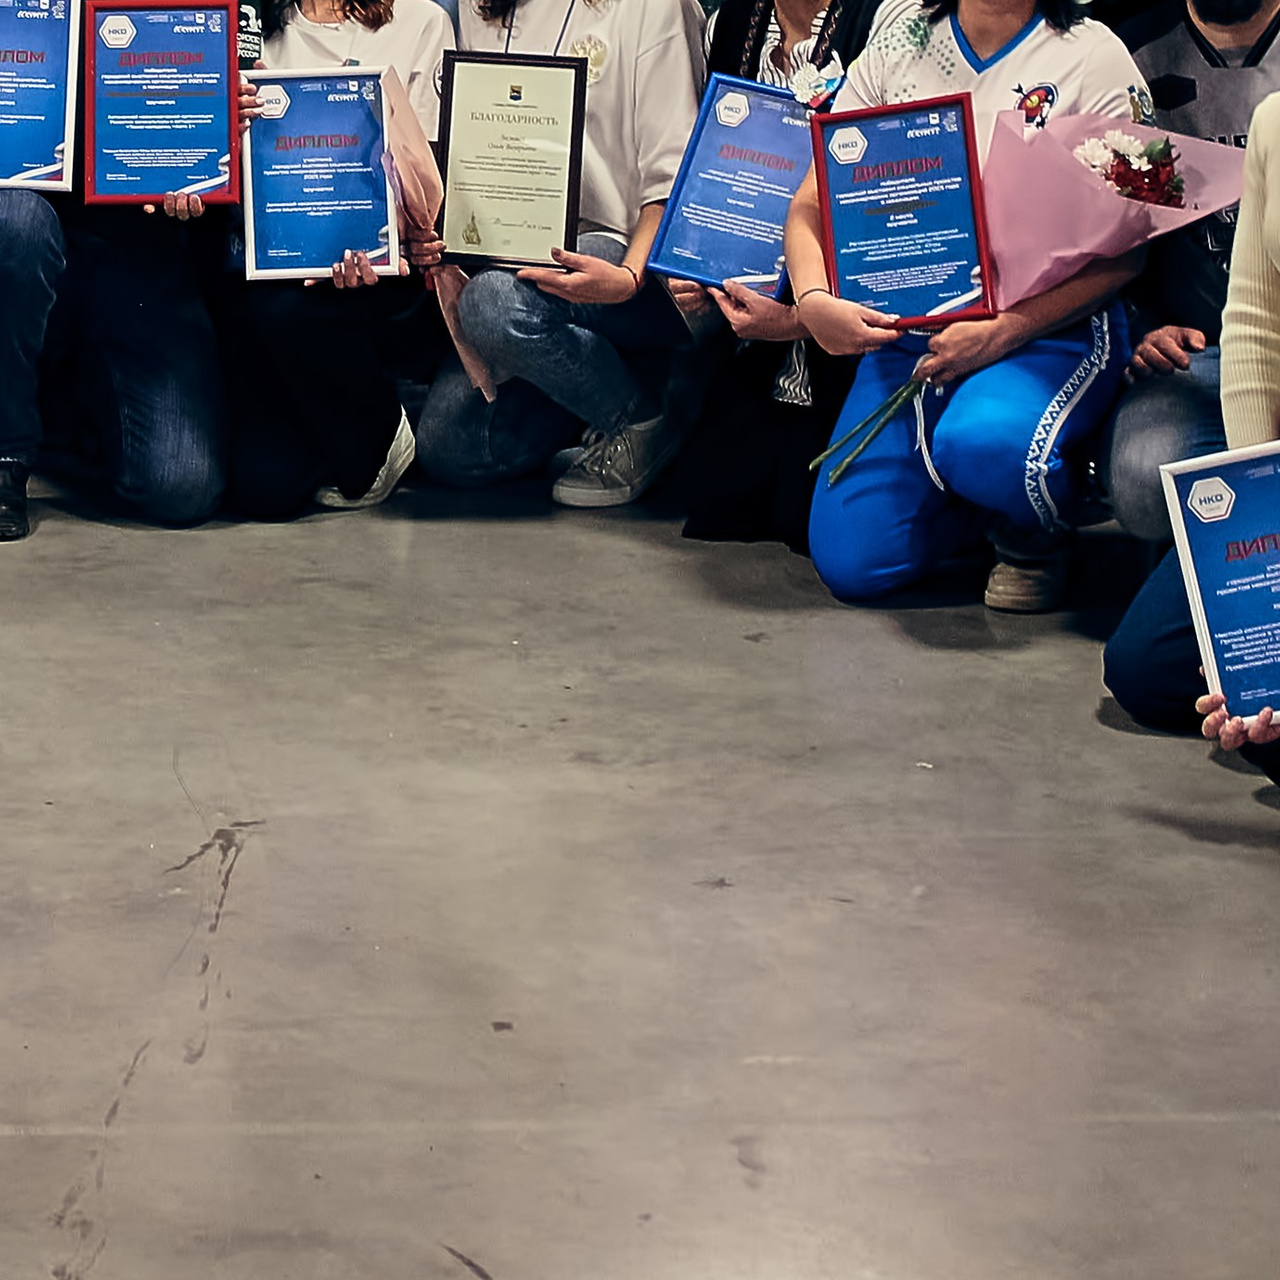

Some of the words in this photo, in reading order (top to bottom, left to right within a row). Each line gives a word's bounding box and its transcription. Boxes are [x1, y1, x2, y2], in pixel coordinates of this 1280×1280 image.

[118, 51, 204, 66] ДИПЛОМ
[470, 111, 559, 126] БЛАГОДАРНОСТЬ
[852, 156, 943, 183] ДИПЛОМ
[1198, 493, 1224, 506] НКО
[1226, 534, 1280, 562] ДИП
